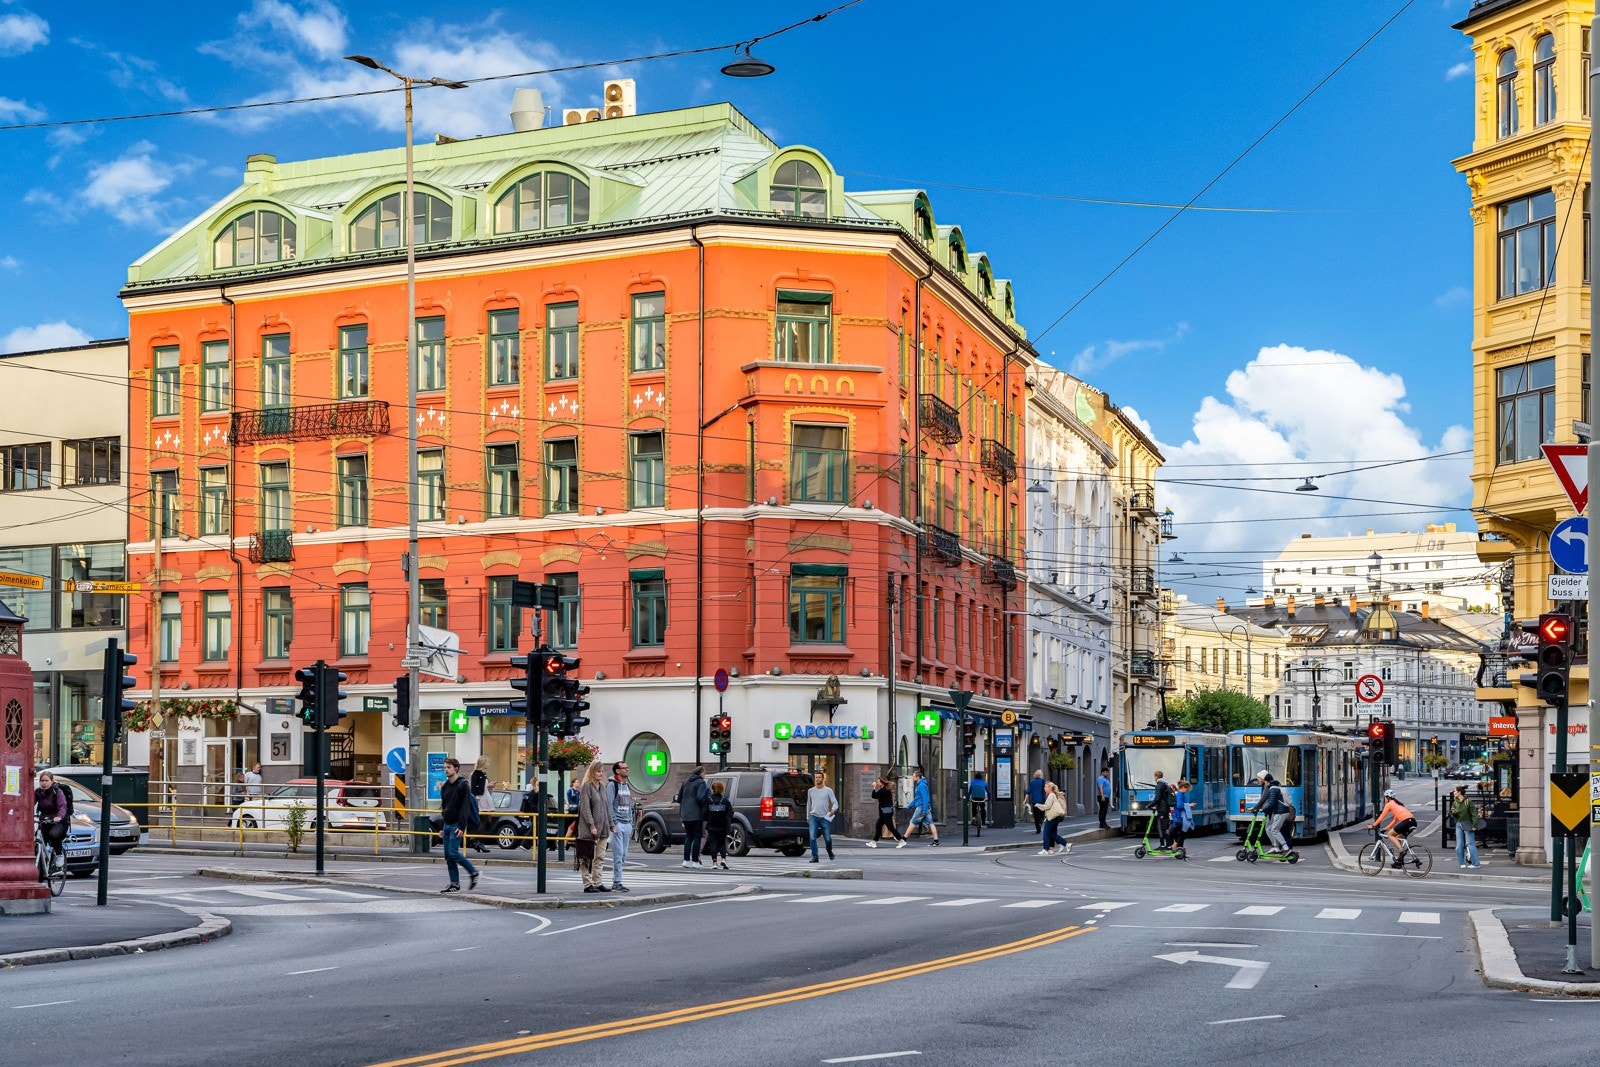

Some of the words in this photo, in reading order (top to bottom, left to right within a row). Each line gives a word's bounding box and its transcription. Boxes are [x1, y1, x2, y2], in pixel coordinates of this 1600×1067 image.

[1551, 577, 1582, 587] Gjelder
[1552, 588, 1573, 596] buss
[1005, 713, 1012, 722] B
[793, 725, 858, 739] APOTEK
[861, 725, 871, 740] 1
[1134, 736, 1141, 744] 12
[1243, 735, 1251, 743] 19
[272, 741, 287, 756] 51
